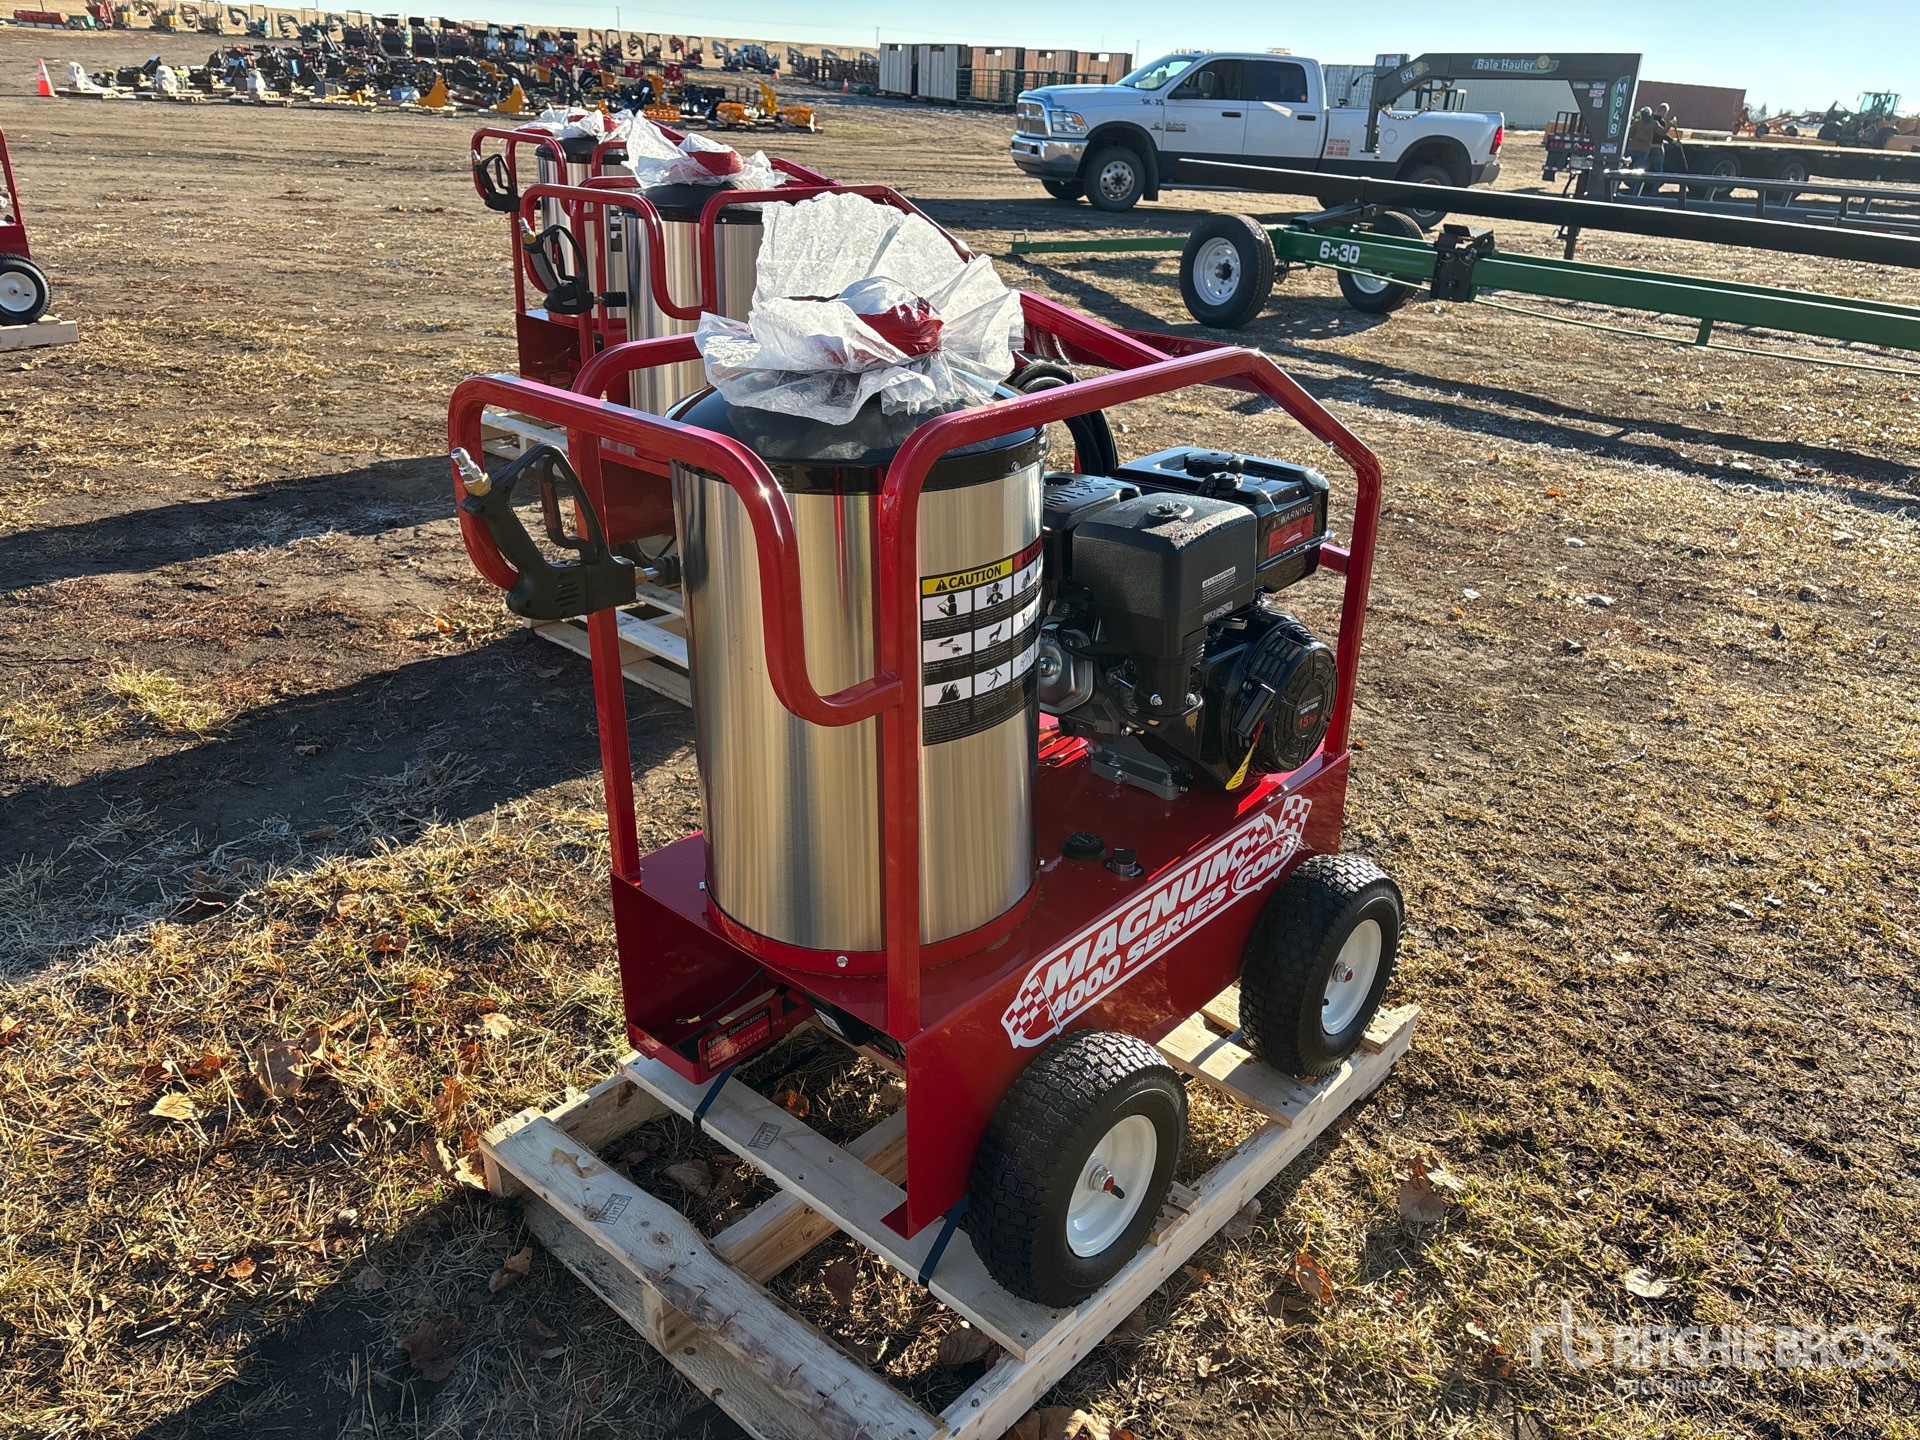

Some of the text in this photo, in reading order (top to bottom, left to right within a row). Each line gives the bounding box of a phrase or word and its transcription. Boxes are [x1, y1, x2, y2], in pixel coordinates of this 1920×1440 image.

[1477, 58, 1535, 70] Bale Hauler
[1280, 503, 1313, 524] WARNING
[948, 564, 1003, 589] CAUTION
[1235, 837, 1297, 887] GOLD
[1044, 838, 1253, 996] MAGNUM
[1048, 881, 1230, 1020] 4000 SERIES
